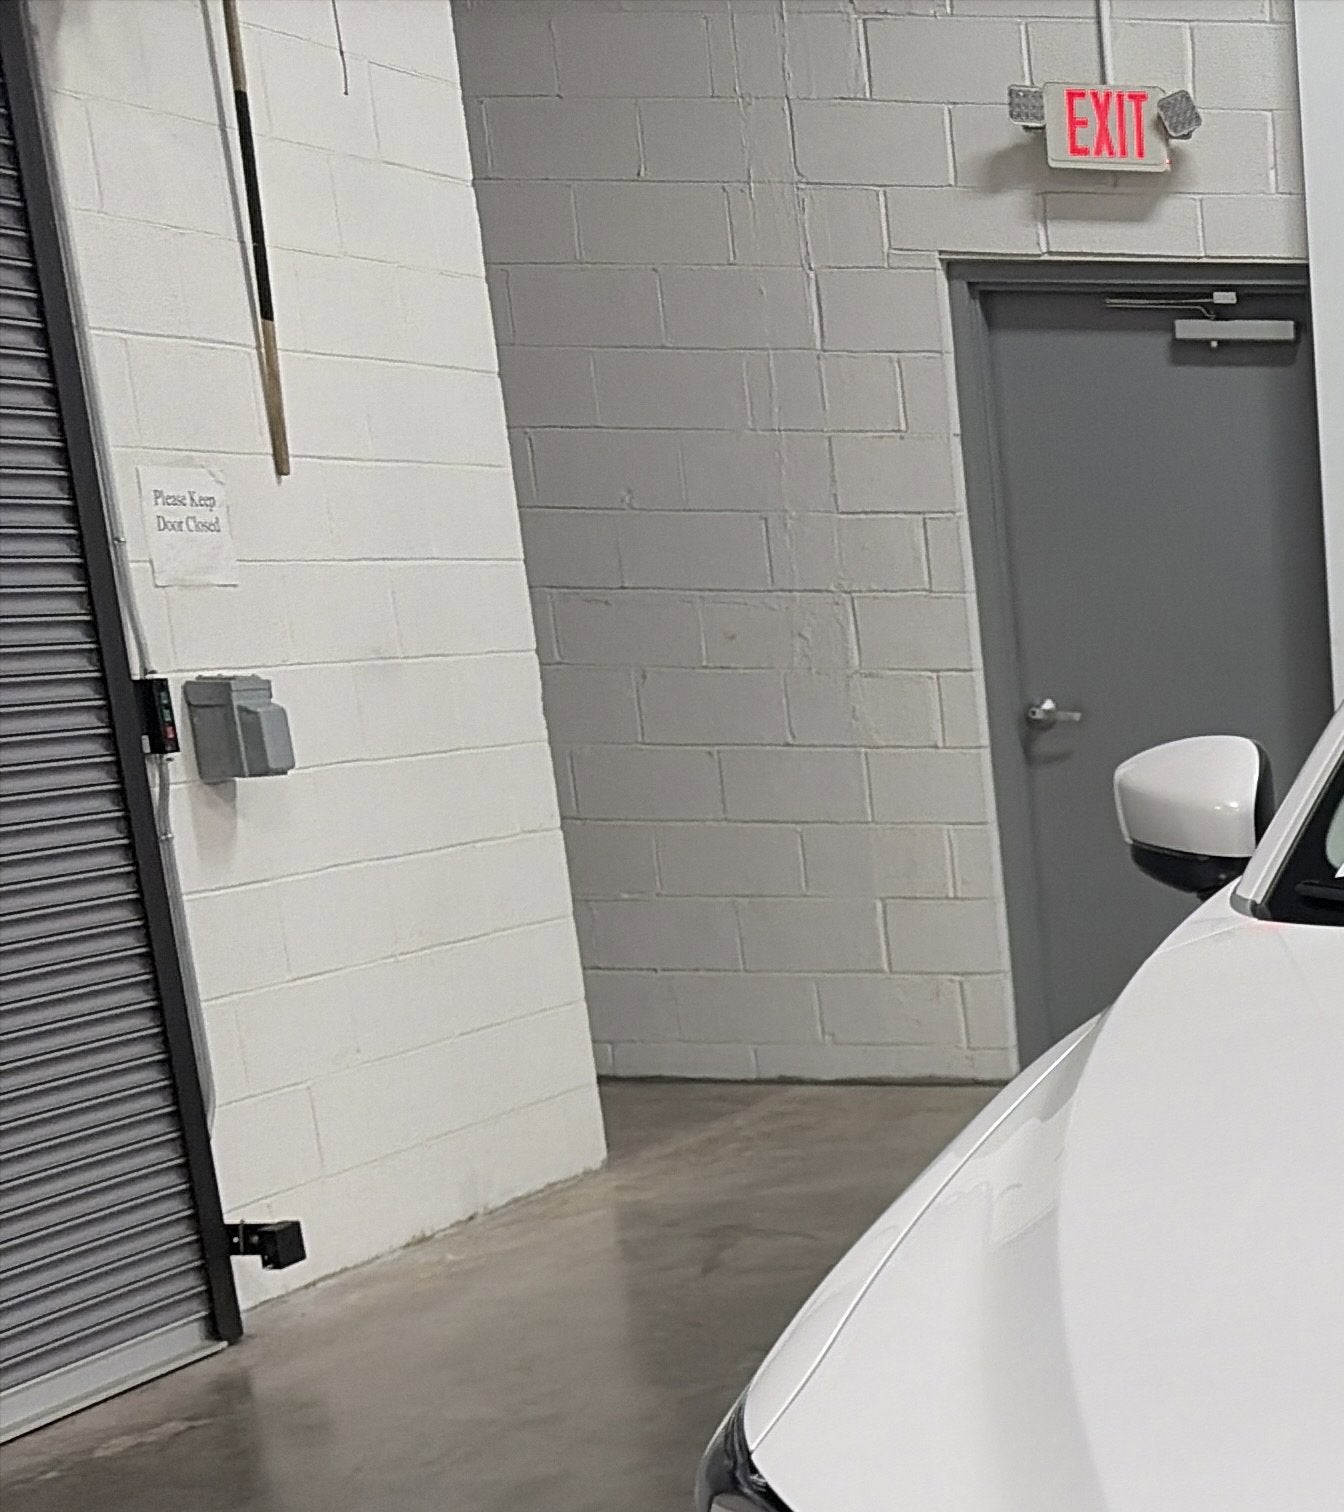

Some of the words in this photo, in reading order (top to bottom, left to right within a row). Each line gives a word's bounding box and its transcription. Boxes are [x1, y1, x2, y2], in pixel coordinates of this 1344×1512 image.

[1064, 88, 1149, 160] EXIT
[153, 489, 187, 507] Please
[187, 490, 216, 512] Keep
[156, 515, 184, 532] Door
[185, 516, 221, 533] Closed
